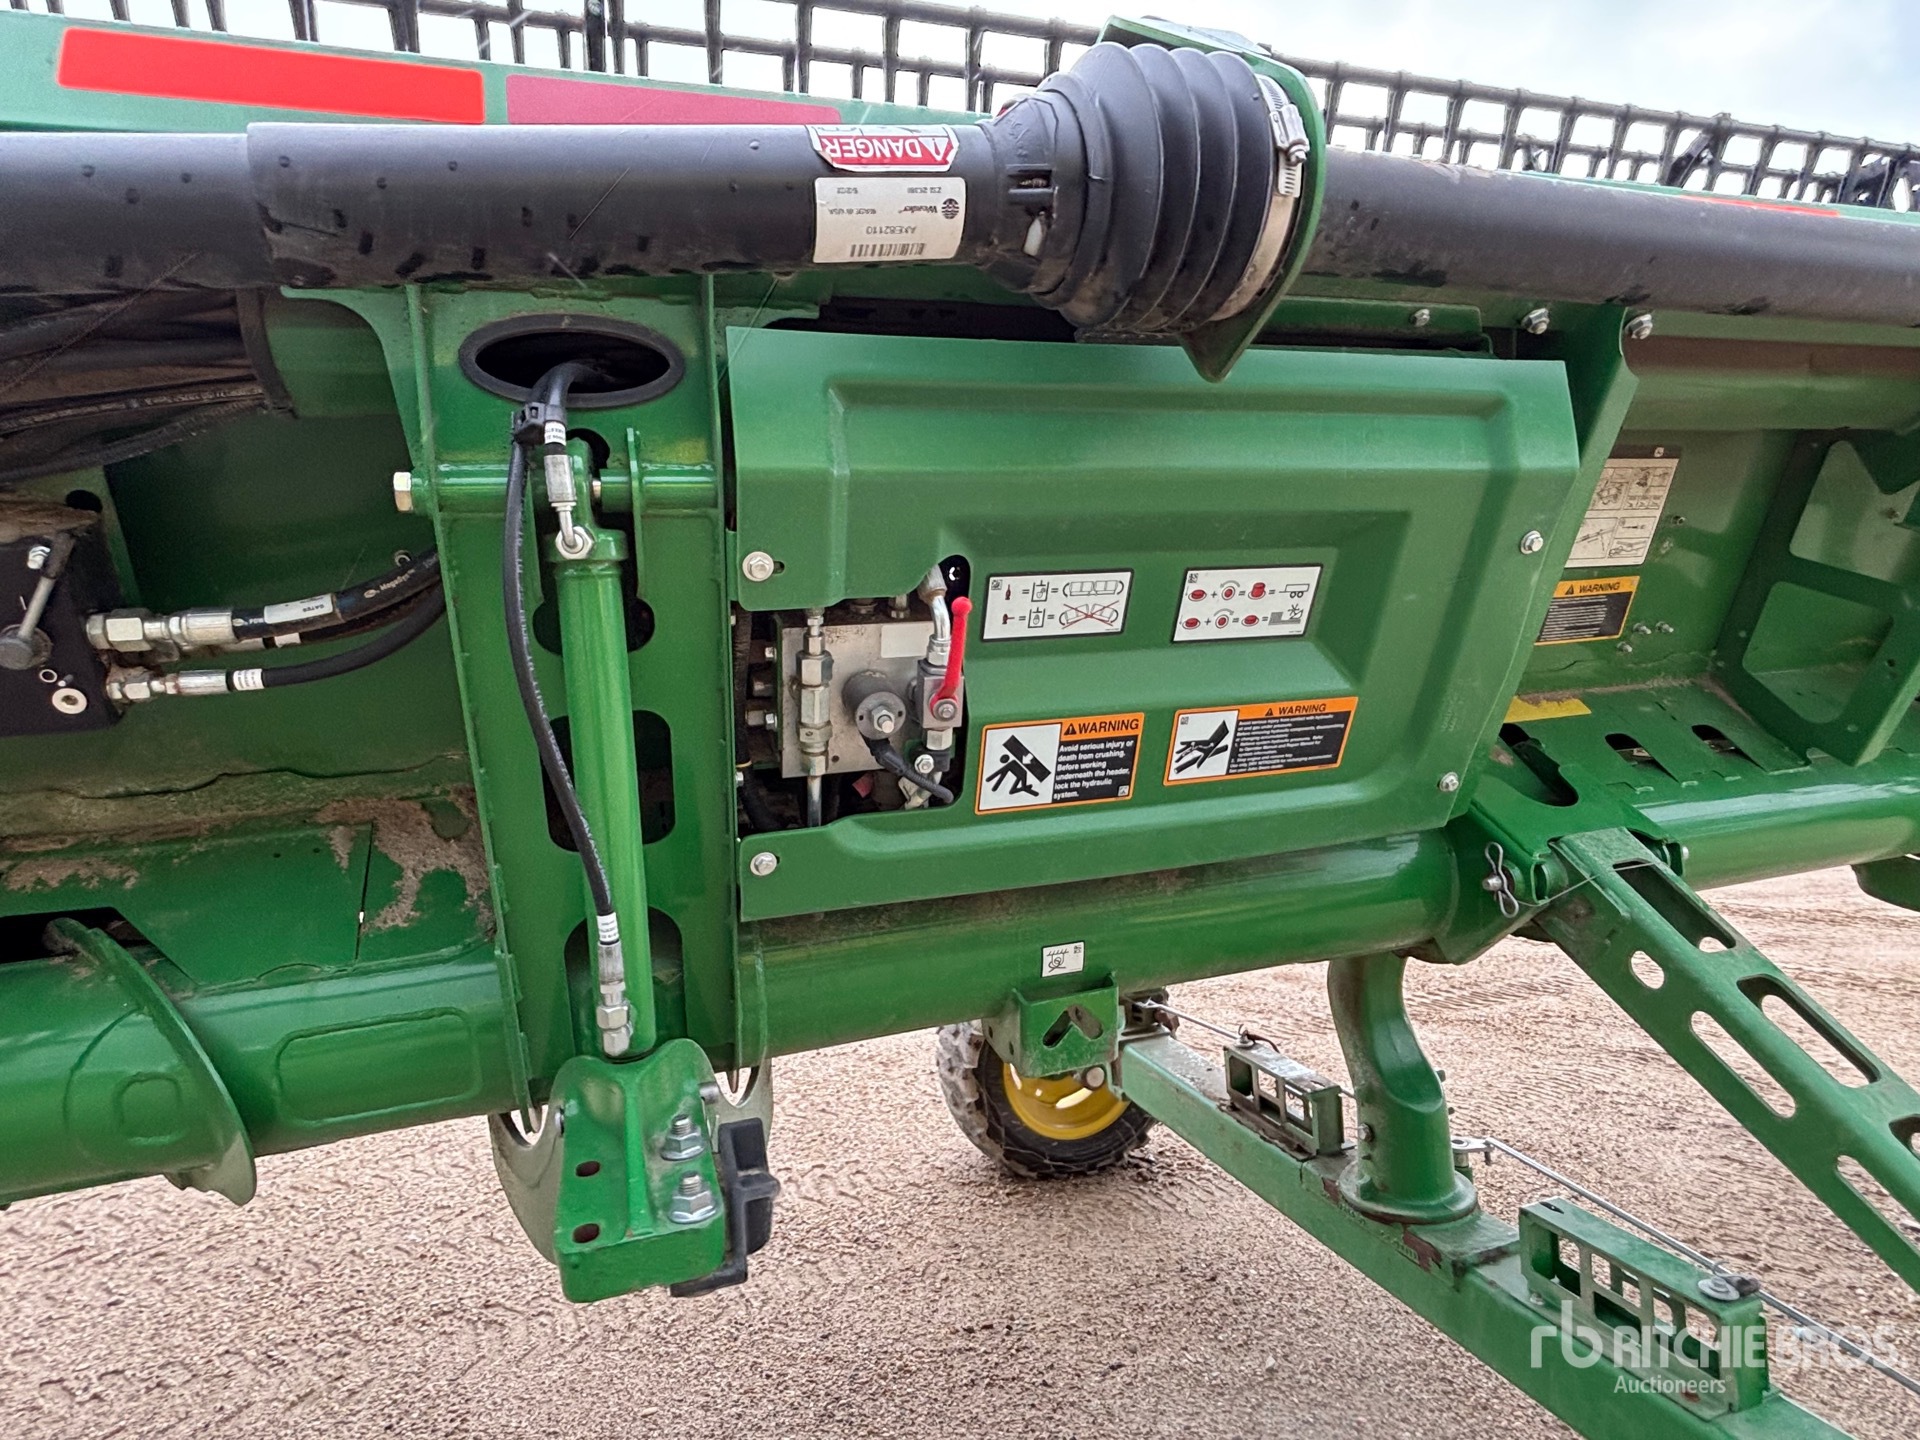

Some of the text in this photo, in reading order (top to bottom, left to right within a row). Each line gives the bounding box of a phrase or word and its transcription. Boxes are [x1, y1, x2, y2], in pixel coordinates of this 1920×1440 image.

[820, 138, 922, 158] DANGER
[1579, 582, 1620, 594] WARNING
[1279, 704, 1326, 715] WARNING
[1078, 718, 1139, 734] WARNING
[1059, 744, 1078, 752] Avoid
[1080, 742, 1104, 750] serious
[1106, 741, 1124, 749] injury
[1058, 754, 1077, 762] death
[1095, 750, 1125, 758] crushing.
[1057, 761, 1107, 771] Before working
[1056, 771, 1093, 780] underneath
[1054, 782, 1068, 790] lock
[1082, 778, 1112, 788] hydraulic
[1053, 791, 1079, 800] system.
